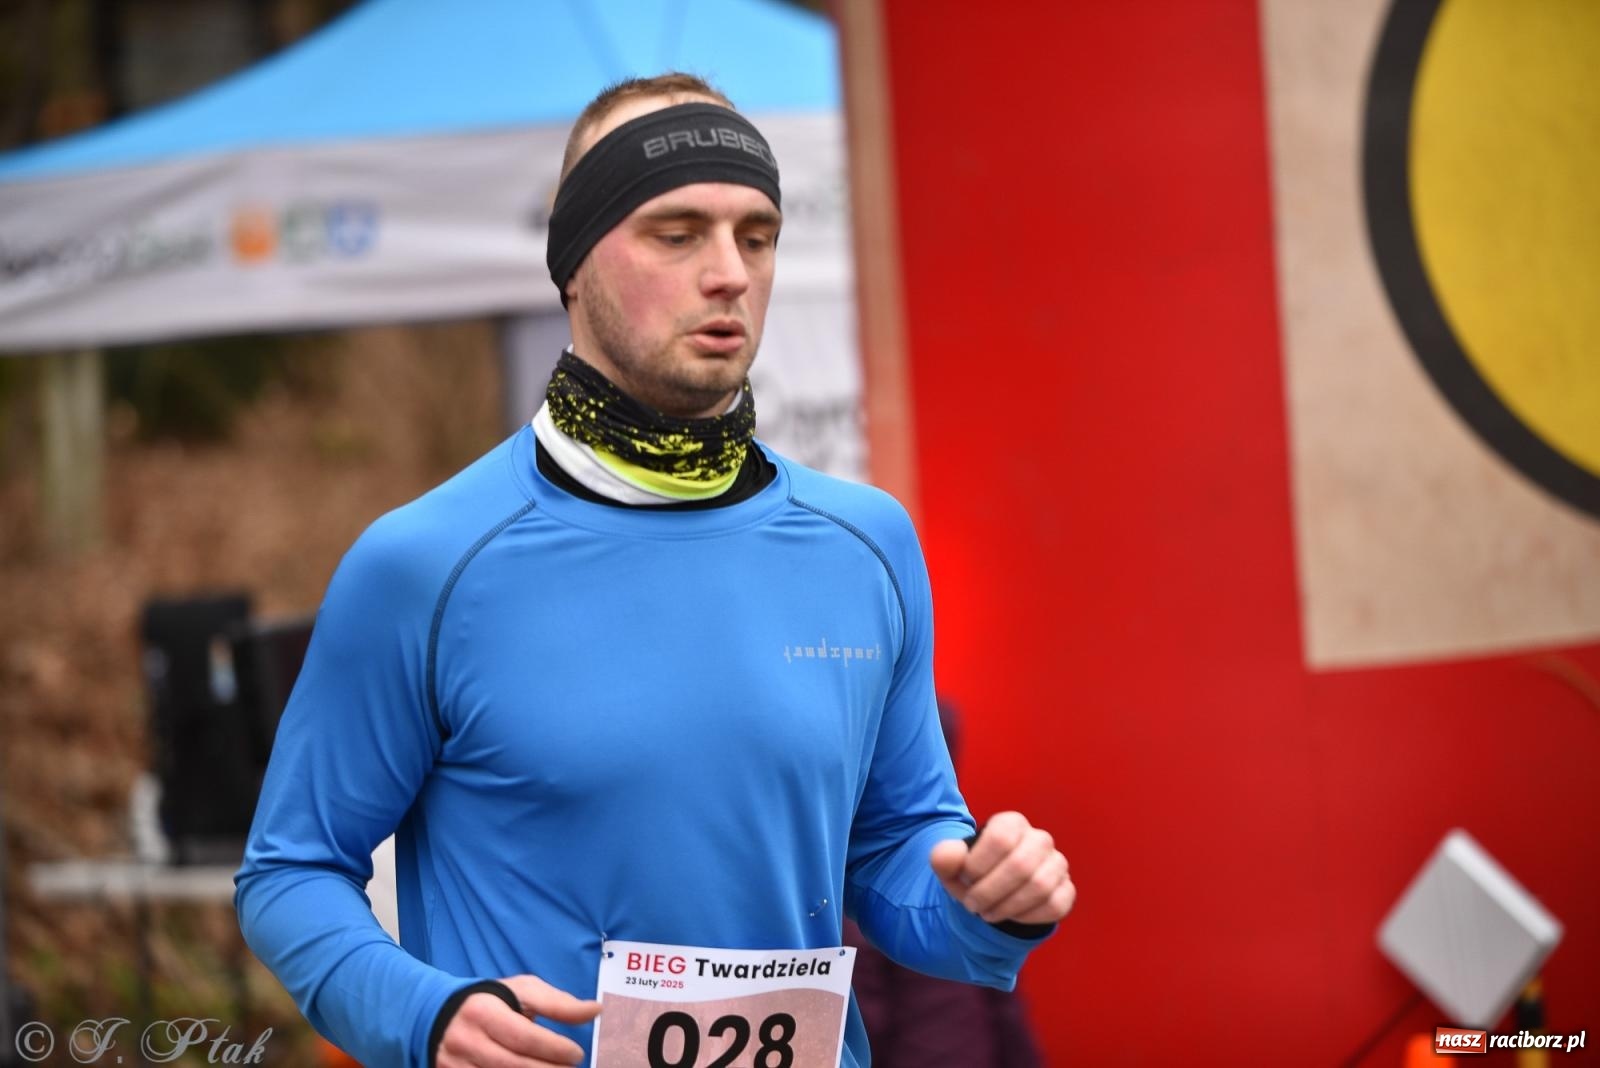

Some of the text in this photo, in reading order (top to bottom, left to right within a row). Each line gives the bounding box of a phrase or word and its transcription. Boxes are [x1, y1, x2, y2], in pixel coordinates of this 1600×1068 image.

[642, 128, 777, 168] BRUBEC
[627, 952, 832, 979] BIEG Twardziela
[625, 976, 684, 990] 23 luty 2025
[647, 1010, 797, 1068] 028
